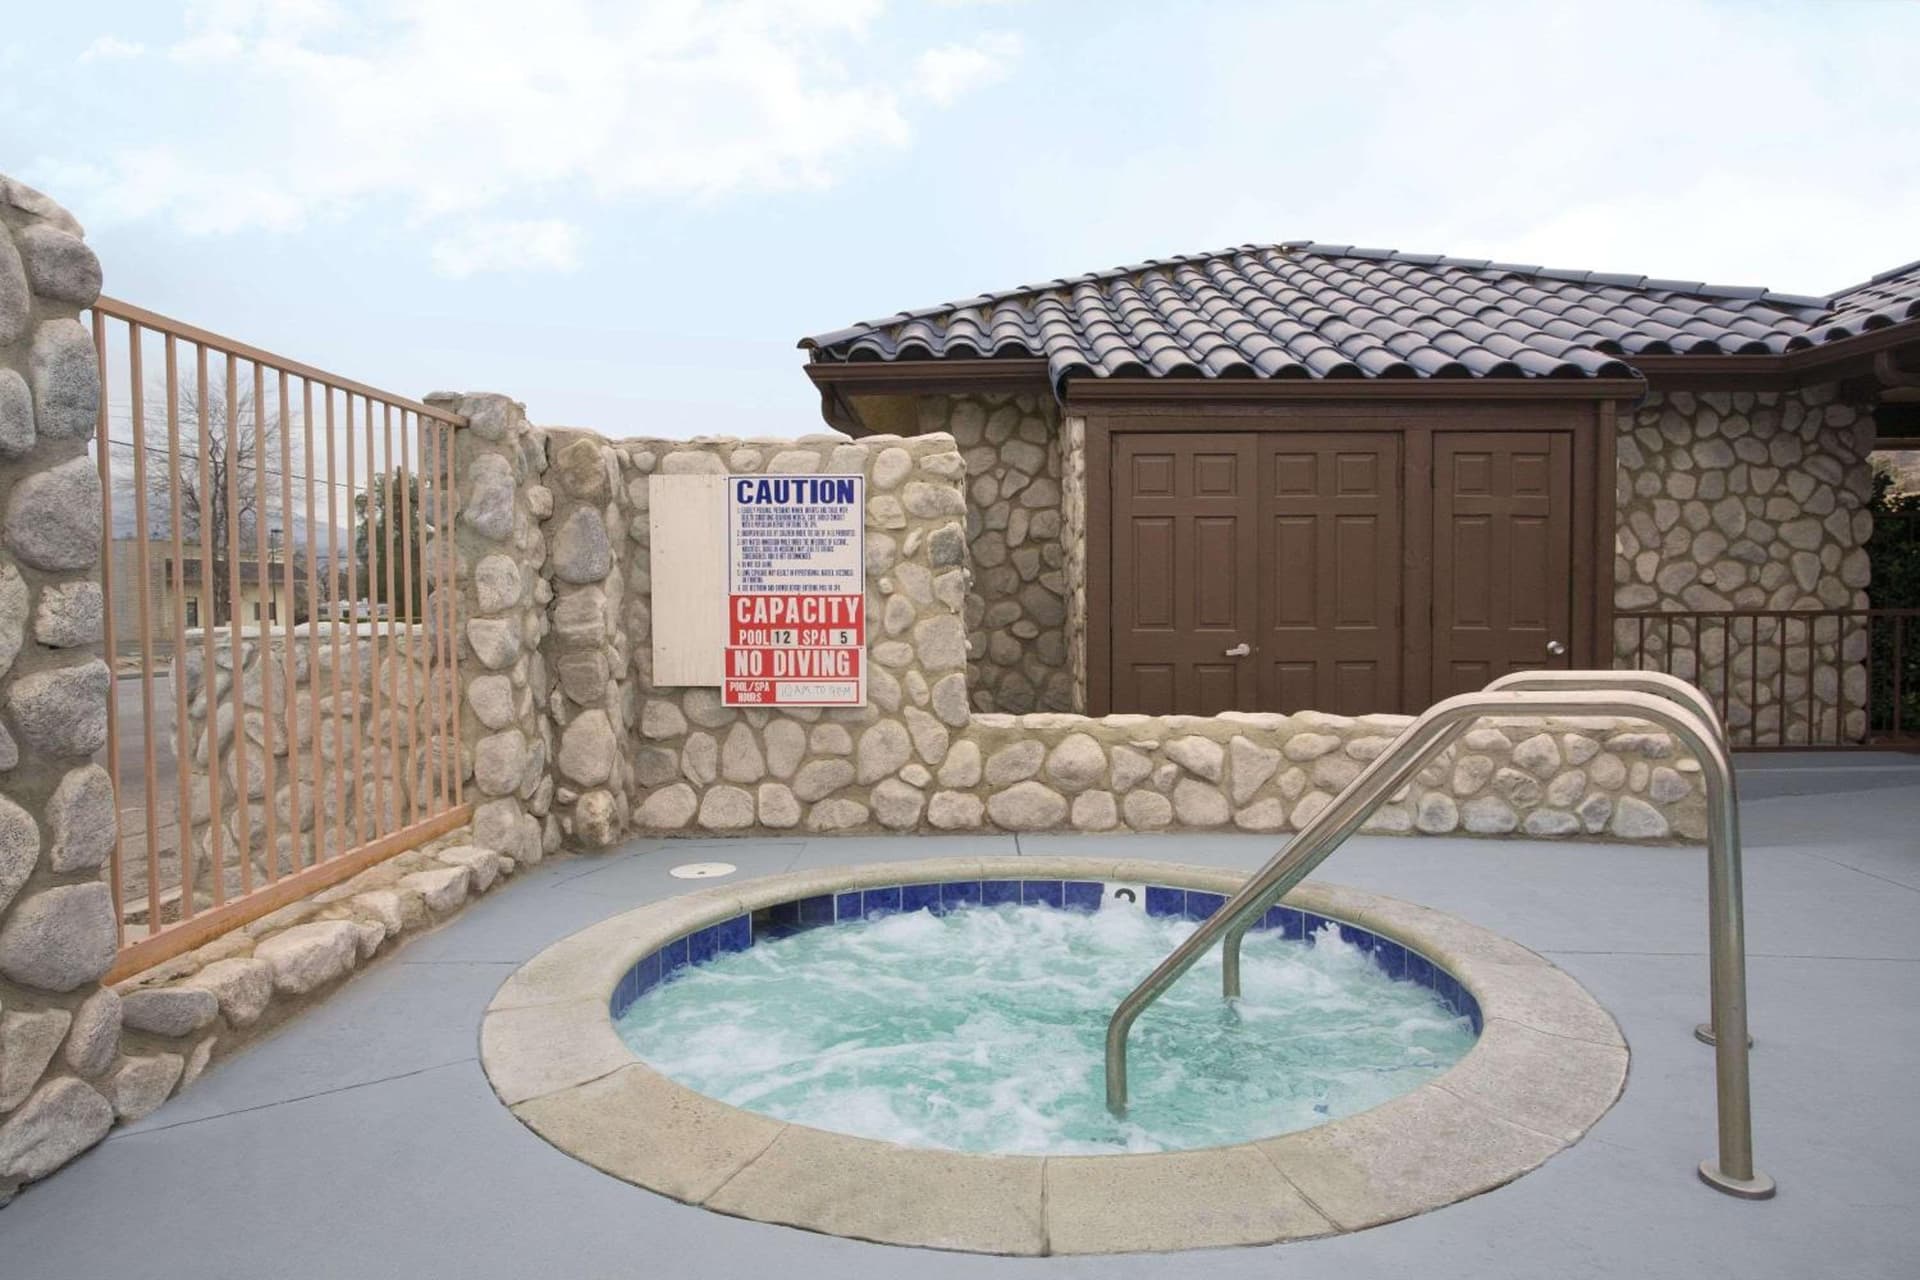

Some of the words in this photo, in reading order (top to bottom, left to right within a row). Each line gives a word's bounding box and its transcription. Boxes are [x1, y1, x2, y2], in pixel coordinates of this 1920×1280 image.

[737, 480, 854, 504] CAUTION
[737, 597, 859, 623] CAPACITY
[739, 629, 769, 645] POOL
[774, 631, 791, 644] 12
[802, 629, 827, 645] SPA
[840, 632, 848, 644] 5
[735, 650, 762, 676] NO
[774, 650, 850, 676] DIVING
[730, 681, 770, 692] POOL/SPA
[738, 692, 762, 702] HOURS
